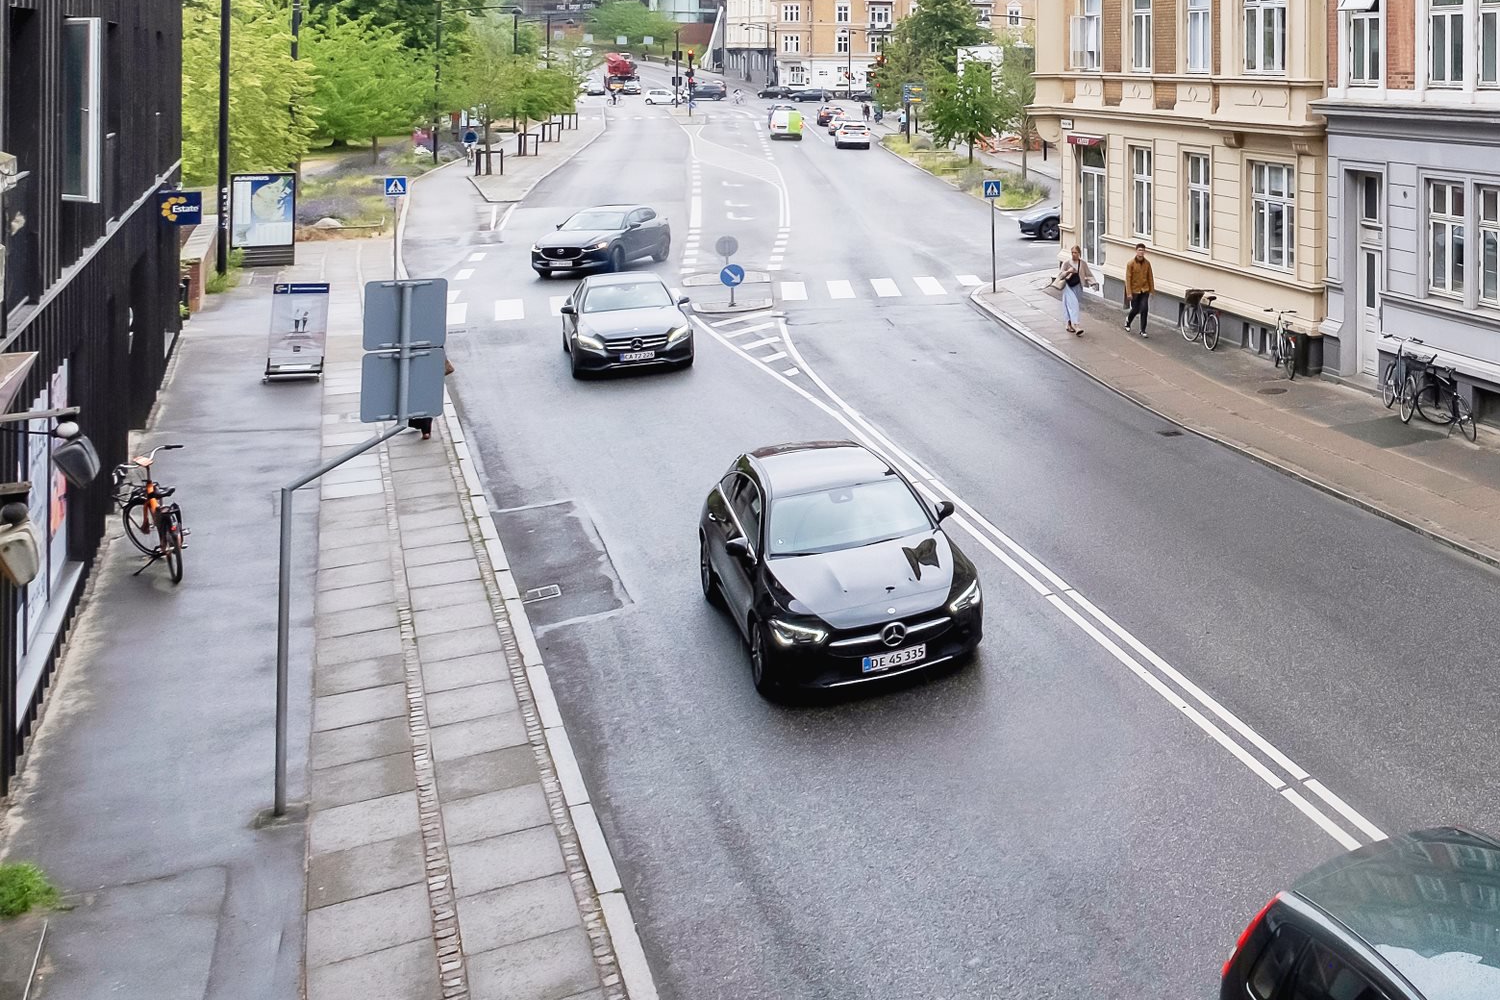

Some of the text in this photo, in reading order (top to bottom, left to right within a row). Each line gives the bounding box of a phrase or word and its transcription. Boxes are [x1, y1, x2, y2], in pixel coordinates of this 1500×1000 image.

[172, 205, 199, 213] Estate
[871, 647, 924, 668] DE 45 335
